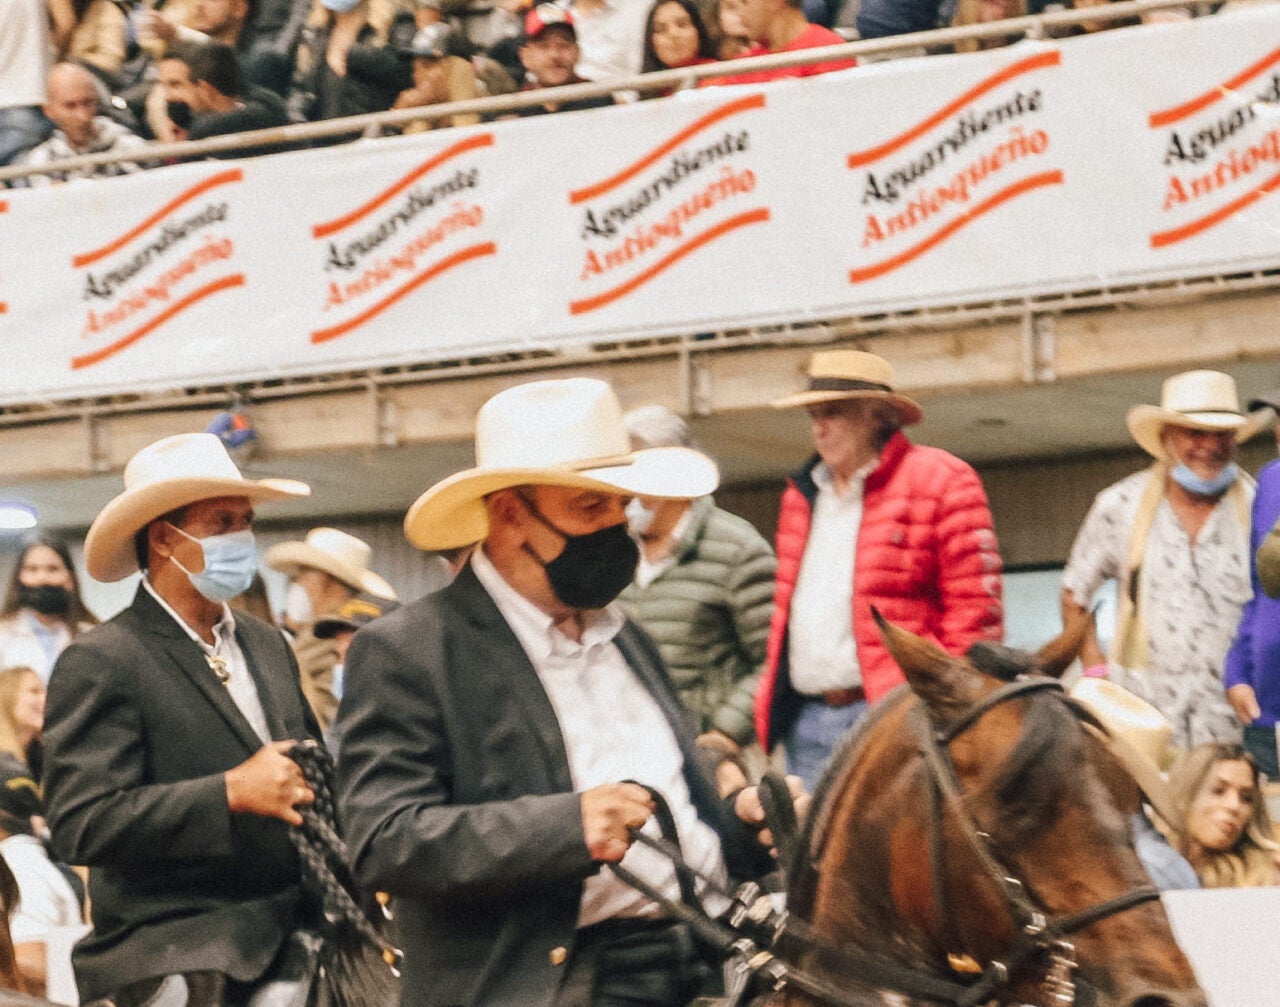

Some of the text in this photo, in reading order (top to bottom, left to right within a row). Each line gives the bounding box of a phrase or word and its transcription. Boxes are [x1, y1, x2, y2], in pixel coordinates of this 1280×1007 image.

[580, 130, 750, 240] Aguardiente
[860, 88, 1042, 205] Aguardiente
[860, 124, 1050, 248] Antioqueño
[580, 165, 758, 281] Antioqueño
